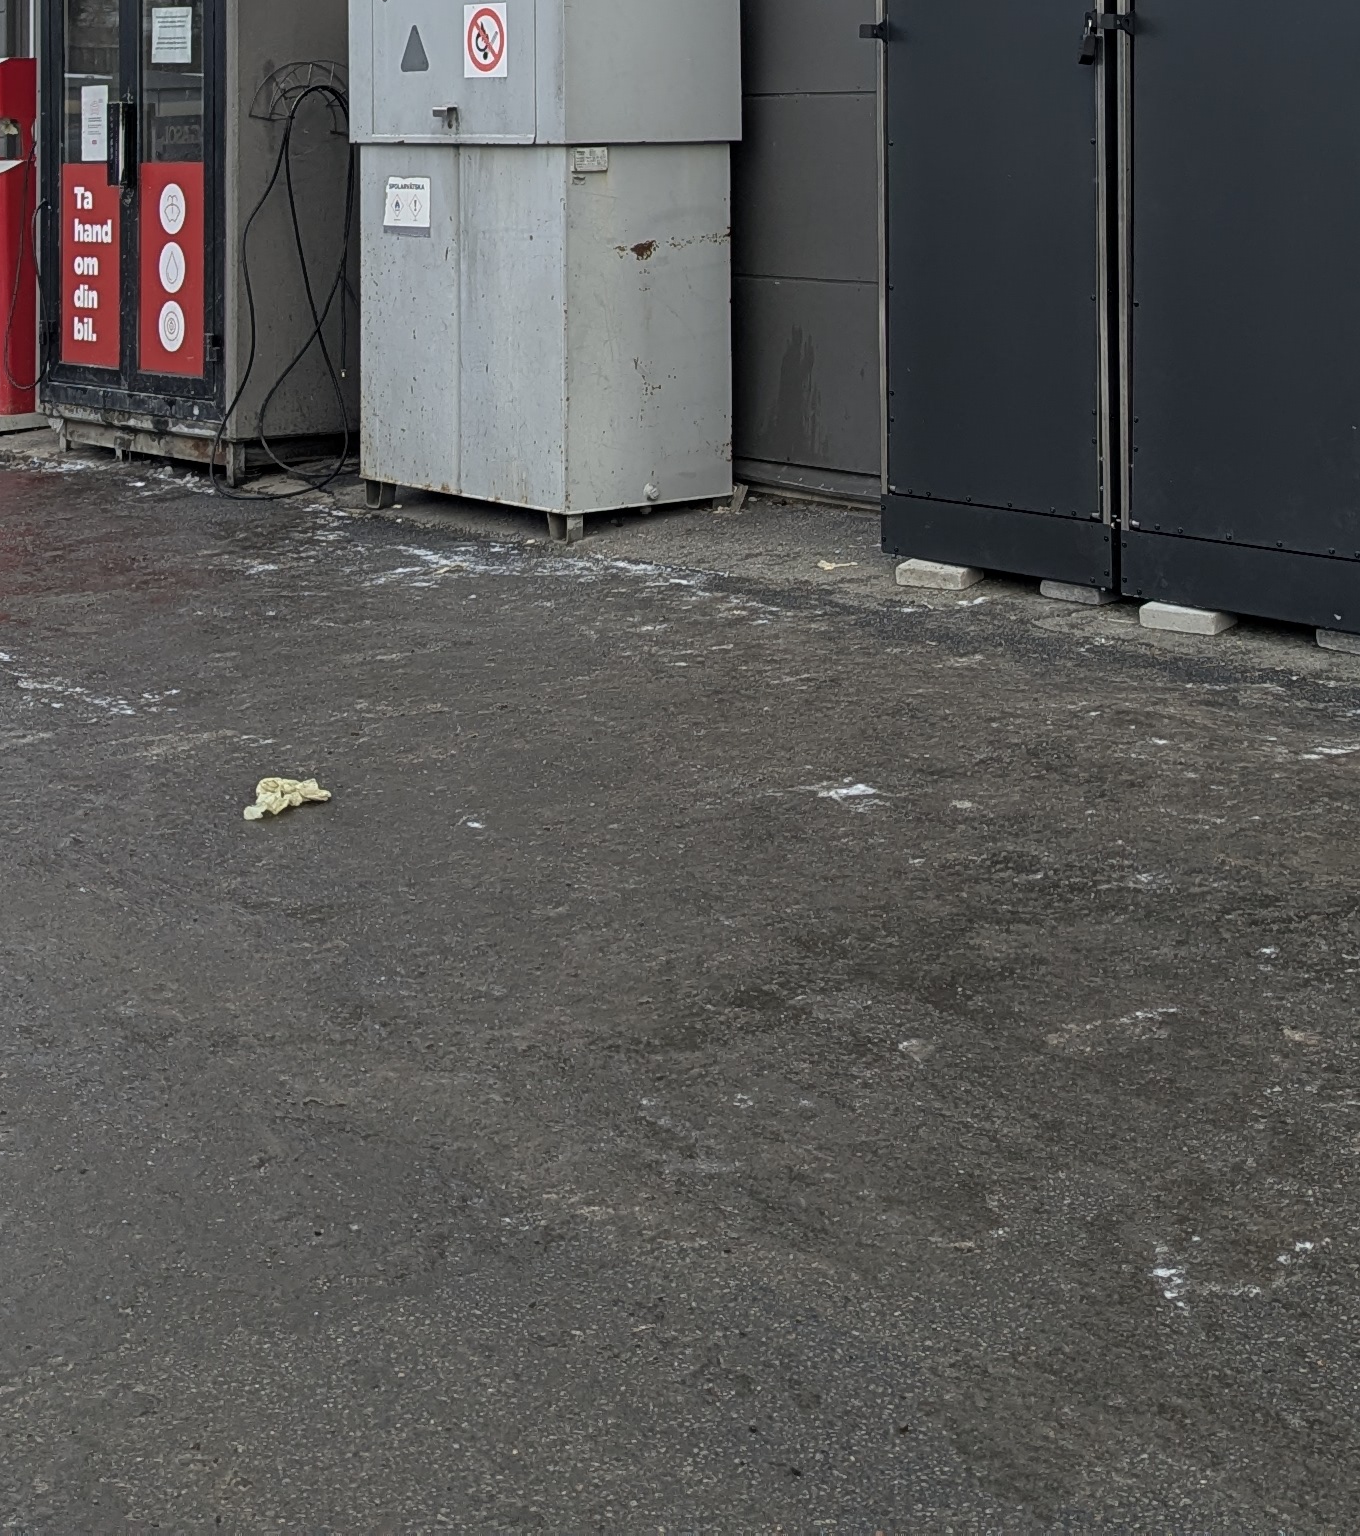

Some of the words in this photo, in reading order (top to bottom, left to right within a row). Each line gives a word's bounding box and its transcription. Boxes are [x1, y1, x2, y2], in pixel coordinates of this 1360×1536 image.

[74, 187, 93, 210] Ta
[74, 218, 112, 243] hand
[74, 256, 99, 276] om
[74, 284, 98, 309] din
[74, 317, 97, 342] bil.
